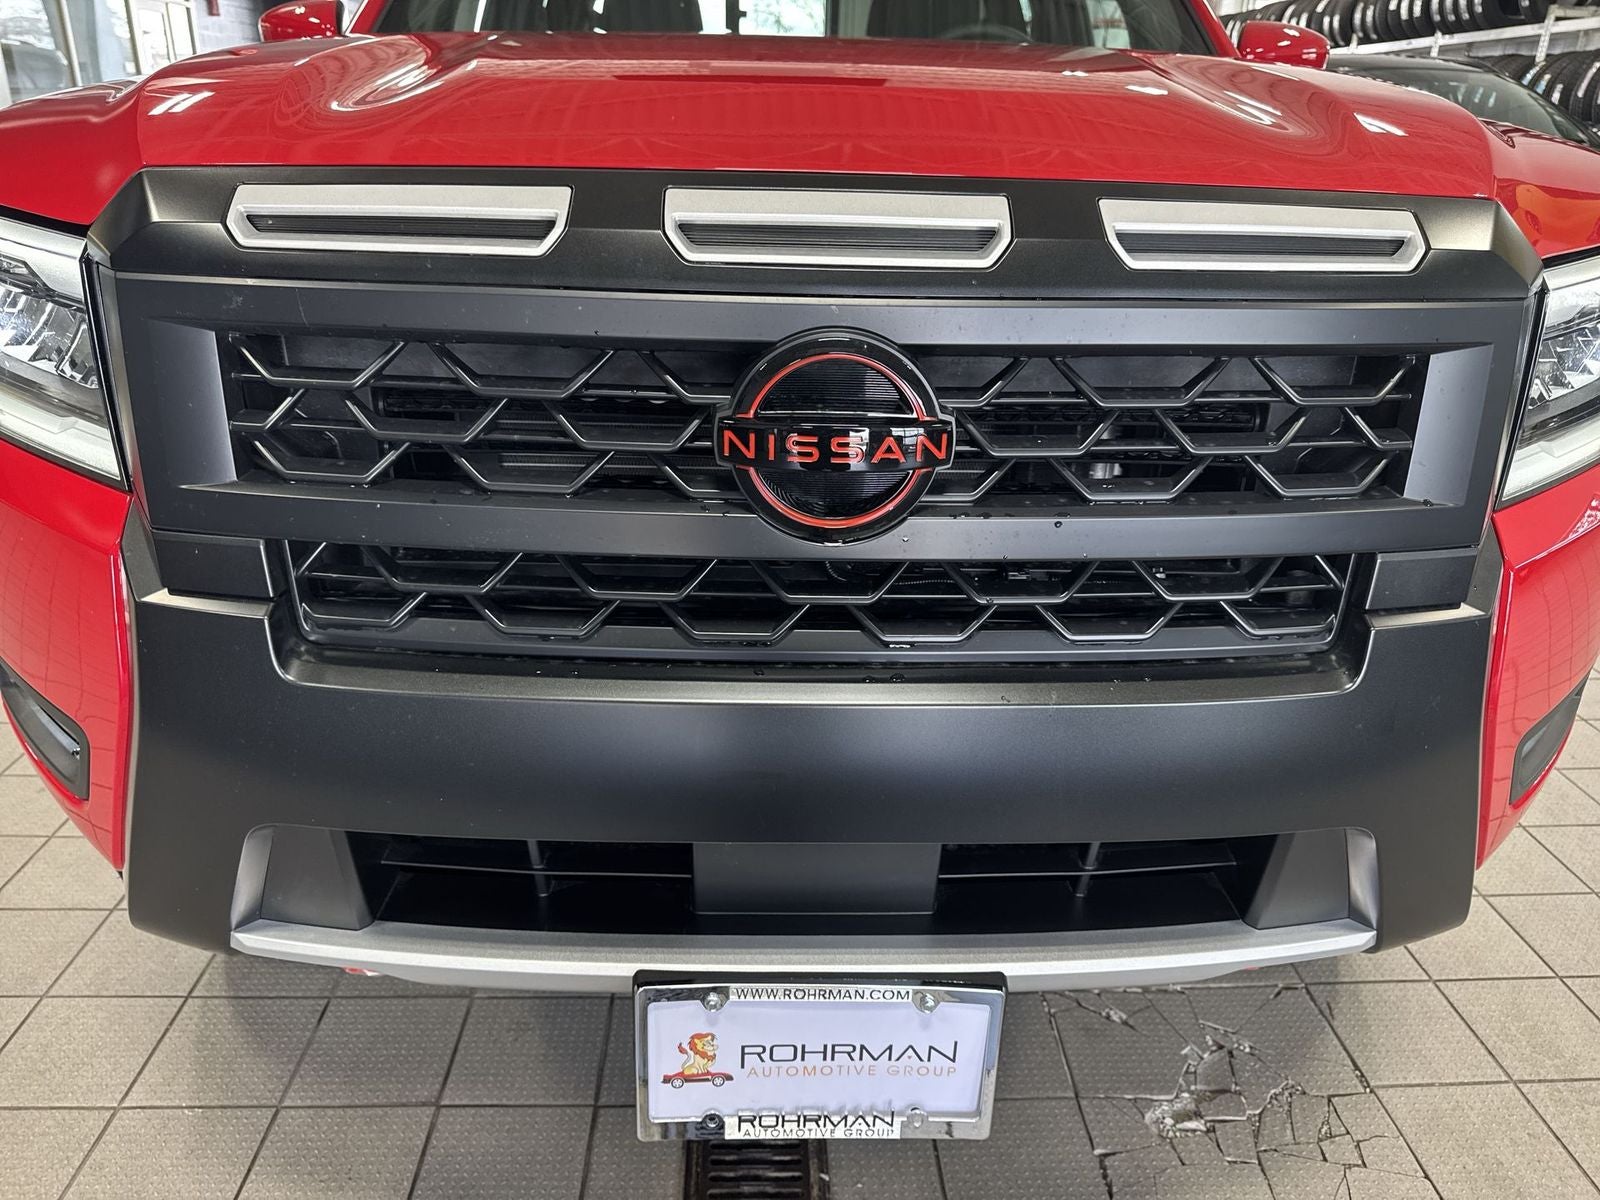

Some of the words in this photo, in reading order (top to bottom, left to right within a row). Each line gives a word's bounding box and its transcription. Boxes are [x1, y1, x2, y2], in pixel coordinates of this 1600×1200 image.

[722, 429, 948, 464] NISSAN
[735, 987, 911, 1001] WWW.ROHRMAN.COM
[740, 1040, 958, 1069] ROHRMAN
[746, 1064, 877, 1079] AUTOMOTIVE
[886, 1065, 957, 1078] GROUP
[737, 1110, 895, 1133] ROHRMAN
[743, 1128, 836, 1138] AUTOMOTIVE
[844, 1128, 895, 1138] GROUP
